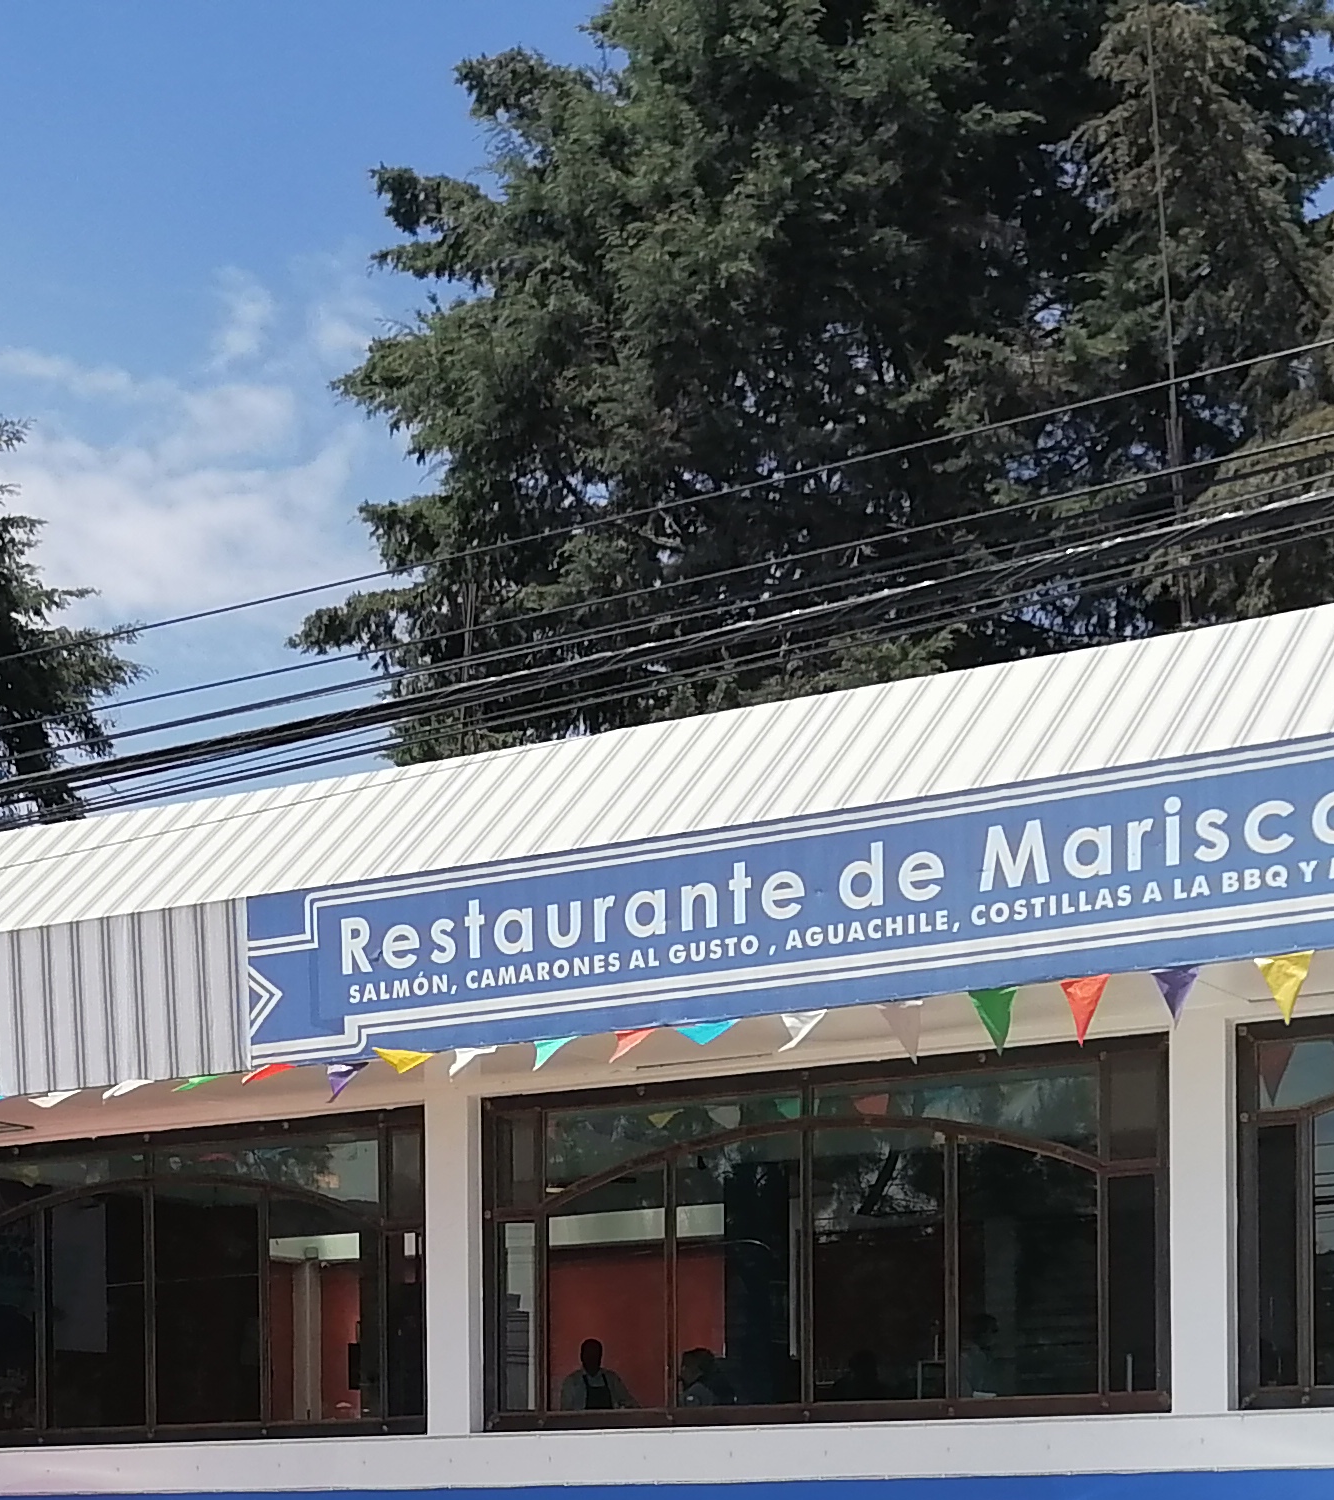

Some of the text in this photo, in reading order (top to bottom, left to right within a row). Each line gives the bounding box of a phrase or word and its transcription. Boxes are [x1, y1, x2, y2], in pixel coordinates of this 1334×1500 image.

[340, 862, 805, 975] Restaurante
[838, 841, 946, 910] de
[349, 971, 459, 1004] SALMÓN,
[465, 952, 621, 990] CAMARONES
[628, 940, 662, 970] AL
[668, 934, 759, 964] GUSTO
[785, 910, 961, 951] AGUACHILE,
[970, 884, 1132, 925] COSTILLAS
[1141, 880, 1163, 903] A
[1172, 871, 1211, 902] LA
[1222, 862, 1289, 894] BBQ
[1298, 858, 1319, 886] Y
